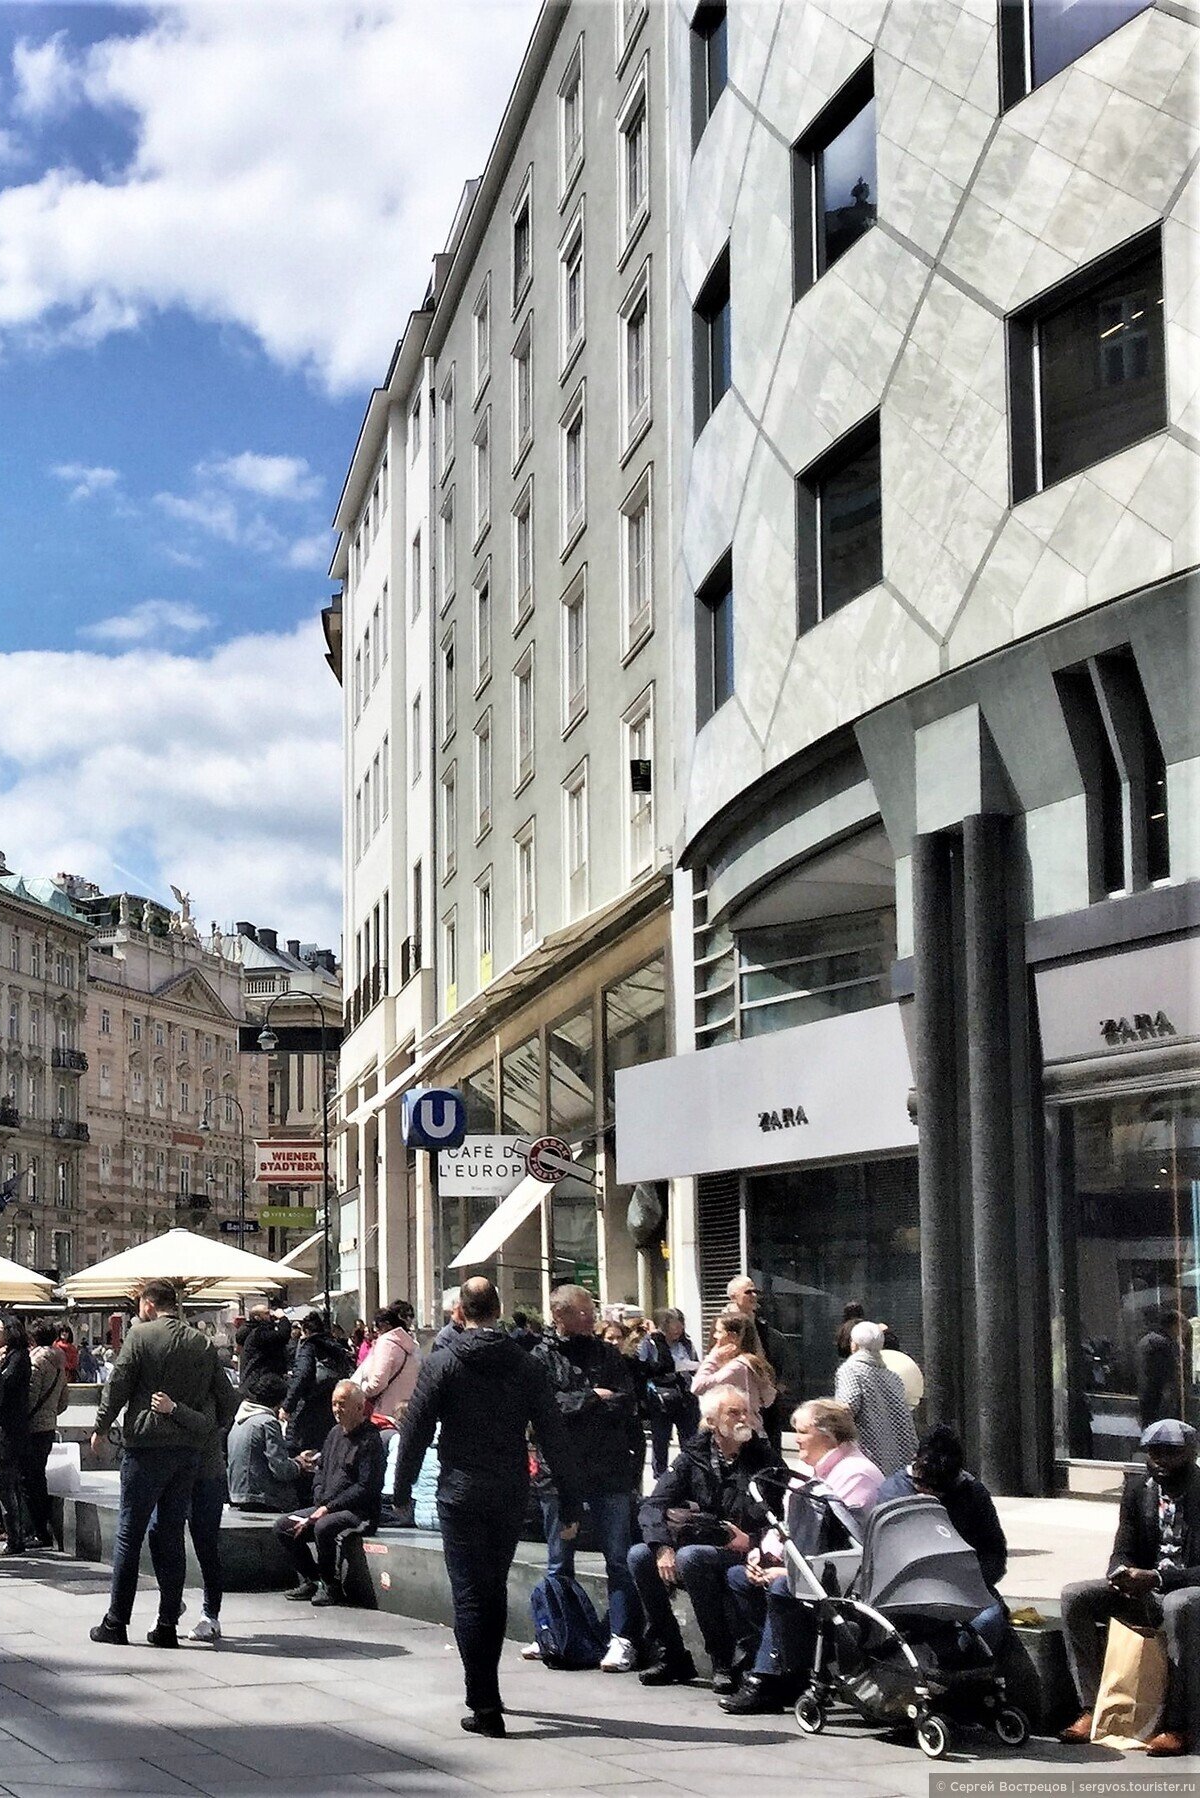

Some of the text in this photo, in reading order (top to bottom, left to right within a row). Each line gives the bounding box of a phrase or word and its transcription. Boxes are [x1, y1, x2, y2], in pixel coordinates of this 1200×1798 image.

[1099, 1010, 1177, 1046] ZARA
[420, 1100, 456, 1139] U
[757, 1104, 809, 1132] ZARA
[271, 1151, 317, 1161] WIENER
[504, 1146, 523, 1158] D
[440, 1164, 527, 1178] L'EUROP
